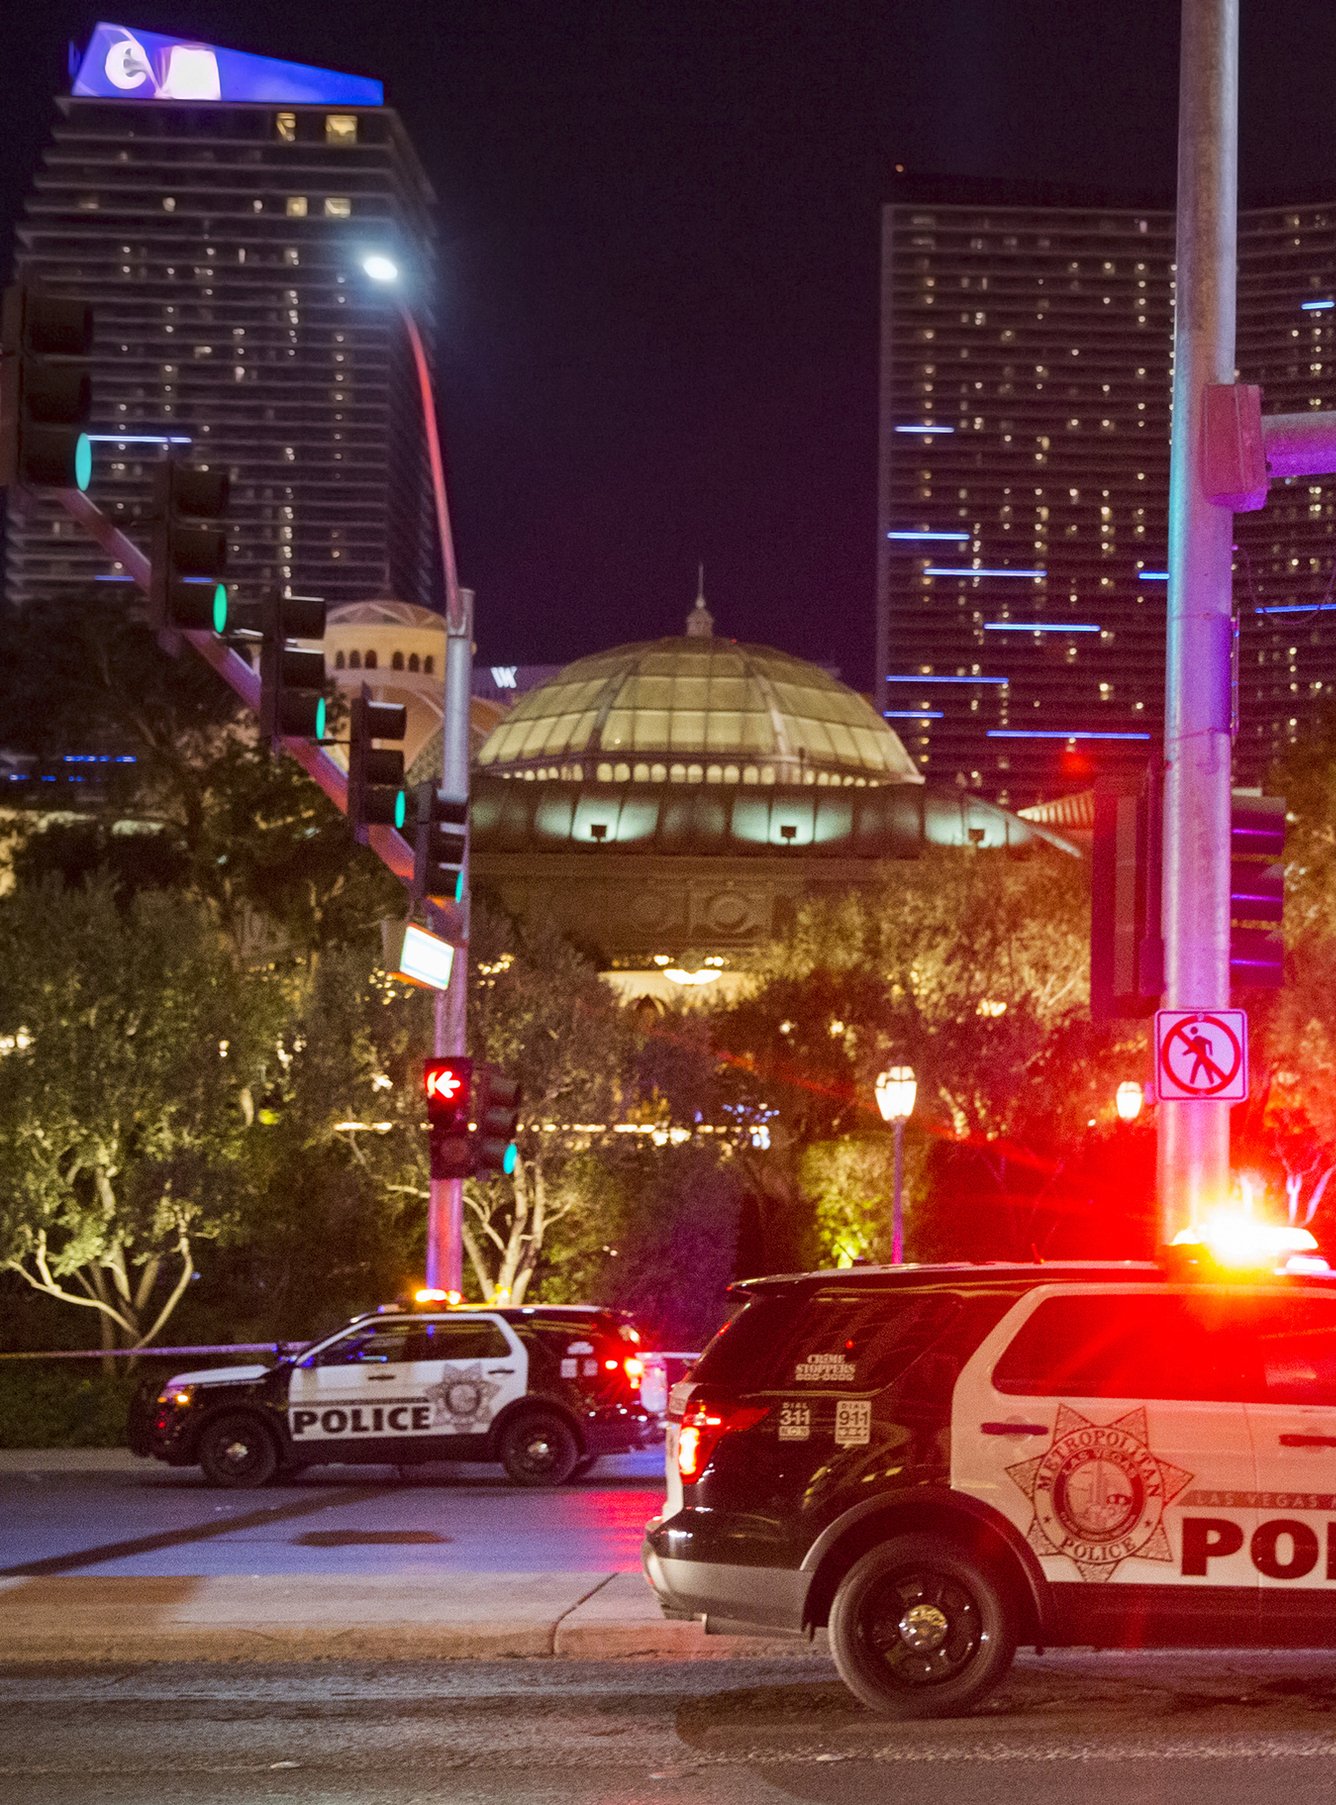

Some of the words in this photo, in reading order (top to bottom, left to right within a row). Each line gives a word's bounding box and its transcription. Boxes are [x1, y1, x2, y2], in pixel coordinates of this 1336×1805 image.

[807, 1353, 846, 1364] CRIME
[795, 1364, 856, 1374] STOPPERS
[293, 1407, 430, 1434] POLICE
[1037, 1430, 1161, 1497] METROPOLITAN
[1198, 1492, 1234, 1505] LAS
[1250, 1494, 1318, 1508] VEGAS
[1059, 1536, 1136, 1560] POLICE
